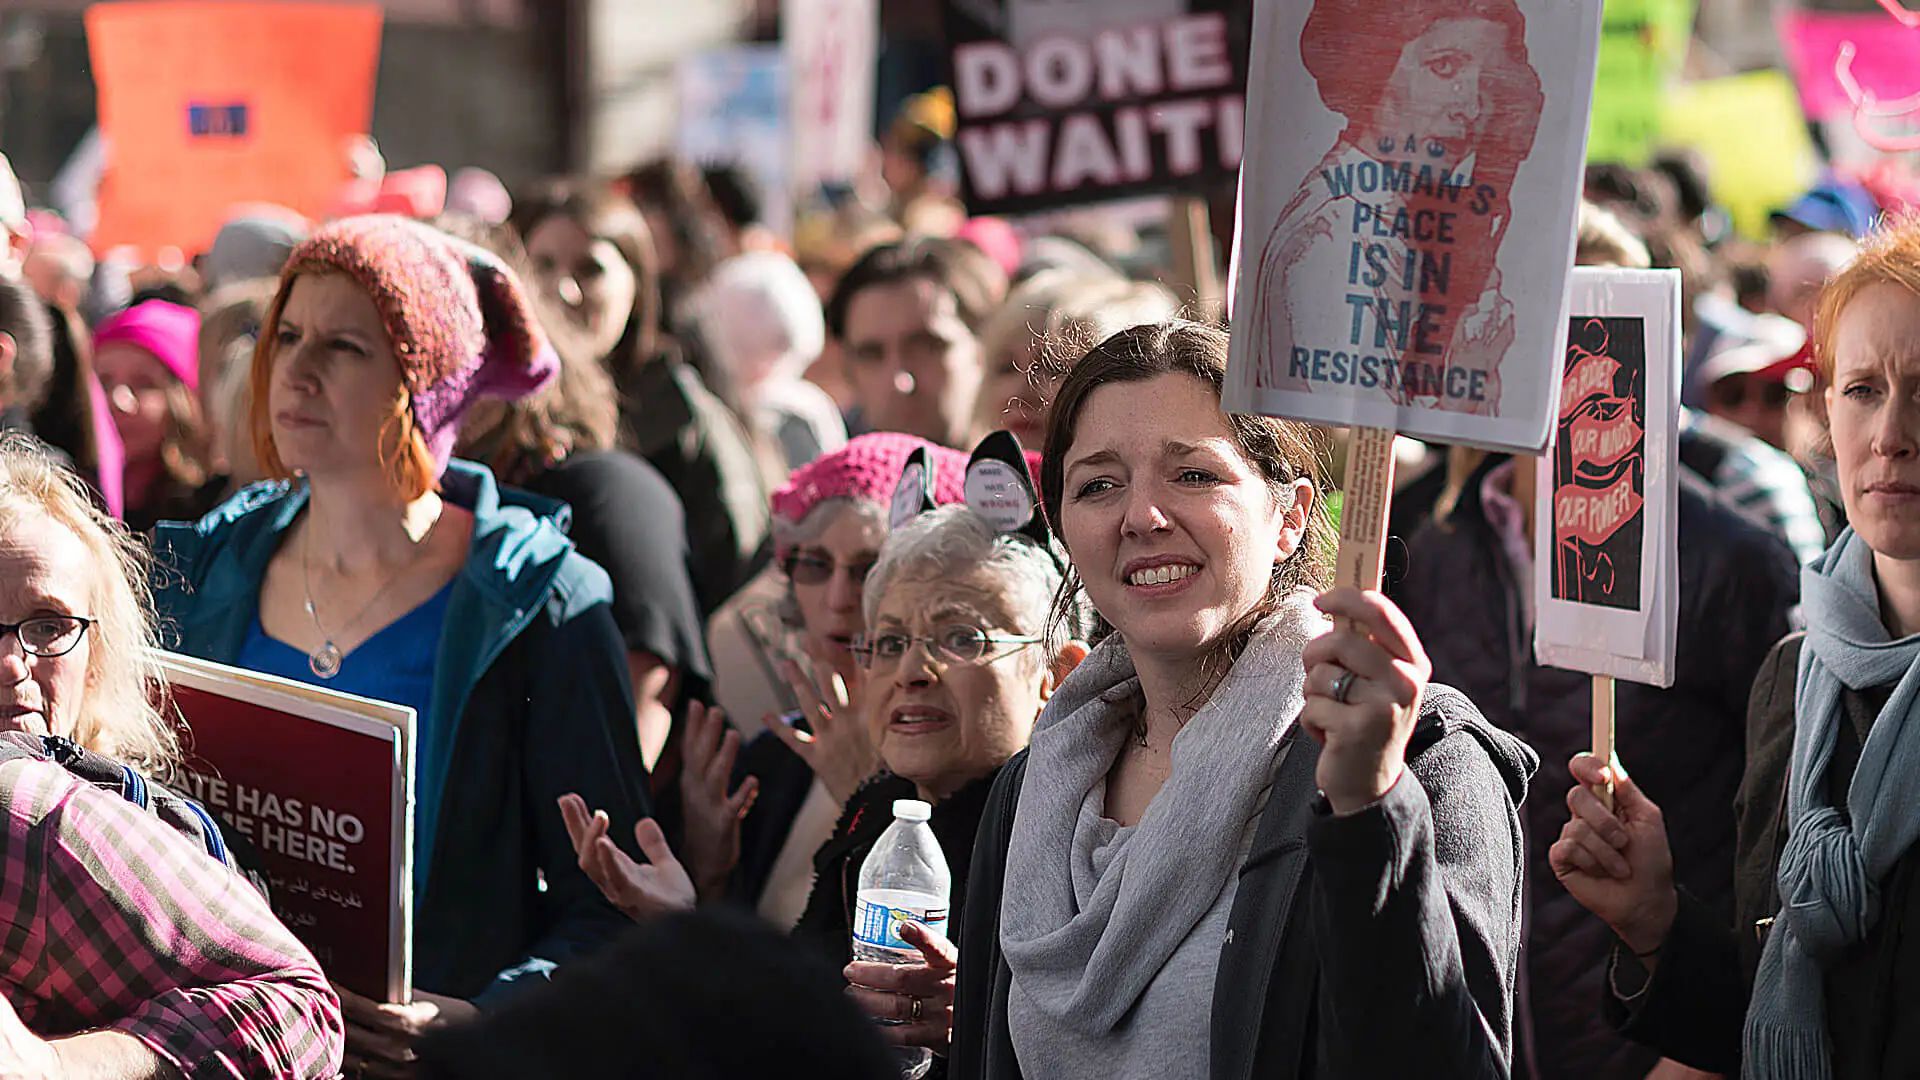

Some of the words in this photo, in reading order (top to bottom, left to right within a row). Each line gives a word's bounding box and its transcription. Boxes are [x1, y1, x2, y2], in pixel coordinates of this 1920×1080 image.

[954, 12, 1233, 117] DONE
[1403, 134, 1417, 153] A
[1320, 160, 1497, 215] WOMAN'S
[1353, 202, 1457, 243] PLACE
[1348, 241, 1388, 288] IS
[1402, 248, 1450, 294] IN
[1346, 293, 1447, 355] THE
[1289, 345, 1488, 401] RESISTANCE
[1574, 428, 1598, 456] OUR
[1559, 496, 1587, 528] OUR
[1589, 481, 1630, 534] POWER
[169, 768, 229, 809] ATE
[236, 784, 303, 828] HAS
[311, 805, 365, 844] NO
[262, 824, 356, 874] HERE.
